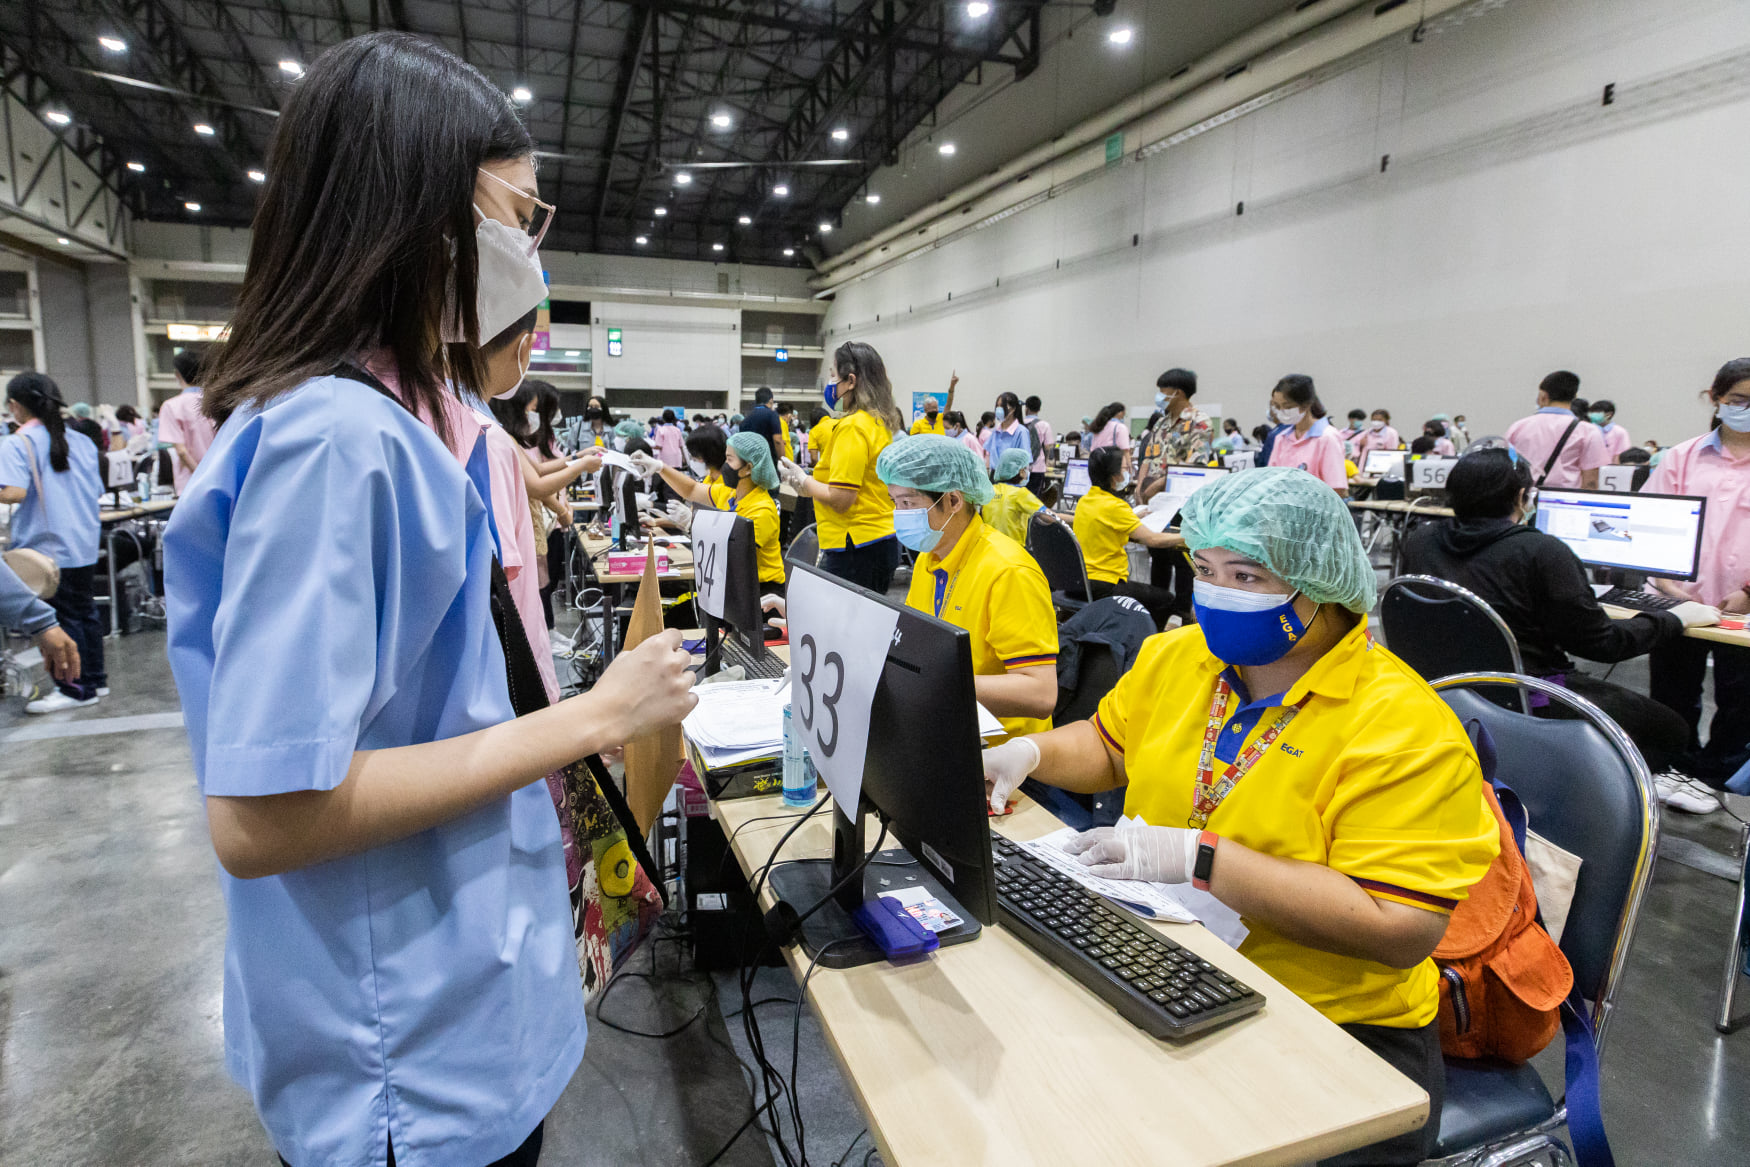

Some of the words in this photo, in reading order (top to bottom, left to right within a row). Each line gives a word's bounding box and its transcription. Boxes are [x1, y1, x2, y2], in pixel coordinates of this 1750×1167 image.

[1422, 468, 1445, 483] 56
[697, 540, 716, 598] 34
[800, 633, 844, 758] 33
[1280, 743, 1304, 758] EGAT
